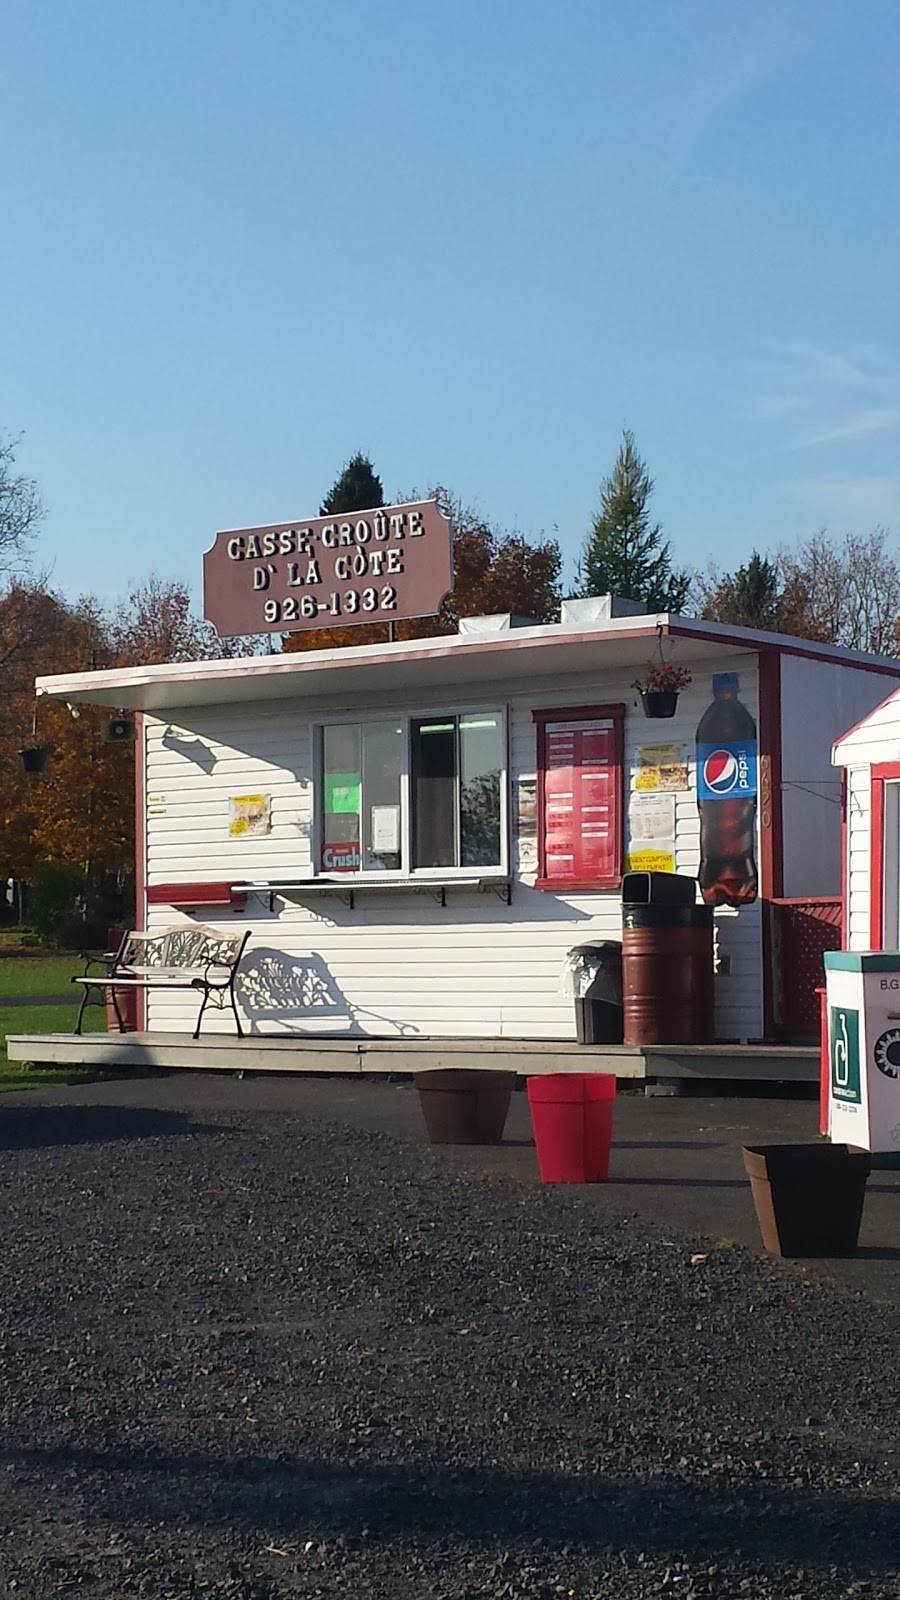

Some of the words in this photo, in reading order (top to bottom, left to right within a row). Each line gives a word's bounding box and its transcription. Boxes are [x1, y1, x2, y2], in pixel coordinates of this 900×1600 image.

[287, 560, 321, 586] LA
[264, 587, 396, 622] 926-1332
[737, 750, 749, 789] pepsi
[322, 847, 360, 868] Crush
